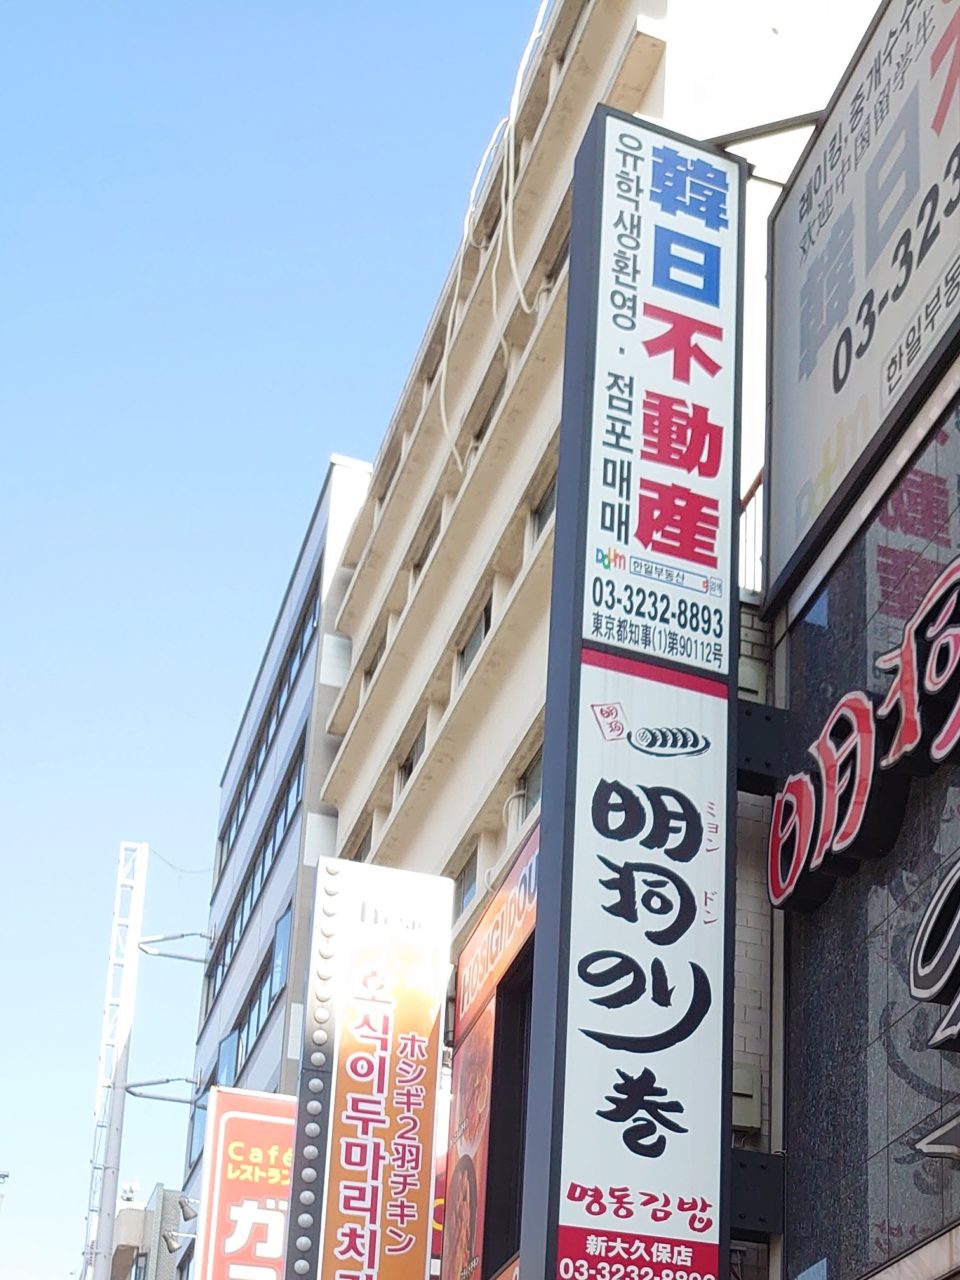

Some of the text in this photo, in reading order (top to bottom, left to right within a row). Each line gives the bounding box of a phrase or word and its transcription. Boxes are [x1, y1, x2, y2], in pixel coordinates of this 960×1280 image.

[600, 132, 645, 547] 유학생환영 점포매매
[634, 143, 731, 570] 韓日不動産
[592, 576, 724, 638] 03-3232-8893
[577, 778, 713, 1159] 明洞のり巻
[384, 1030, 431, 1256] ホシギ2羽チキン
[566, 1182, 713, 1235] 명동김밥
[585, 1235, 694, 1268] 新大久保店
